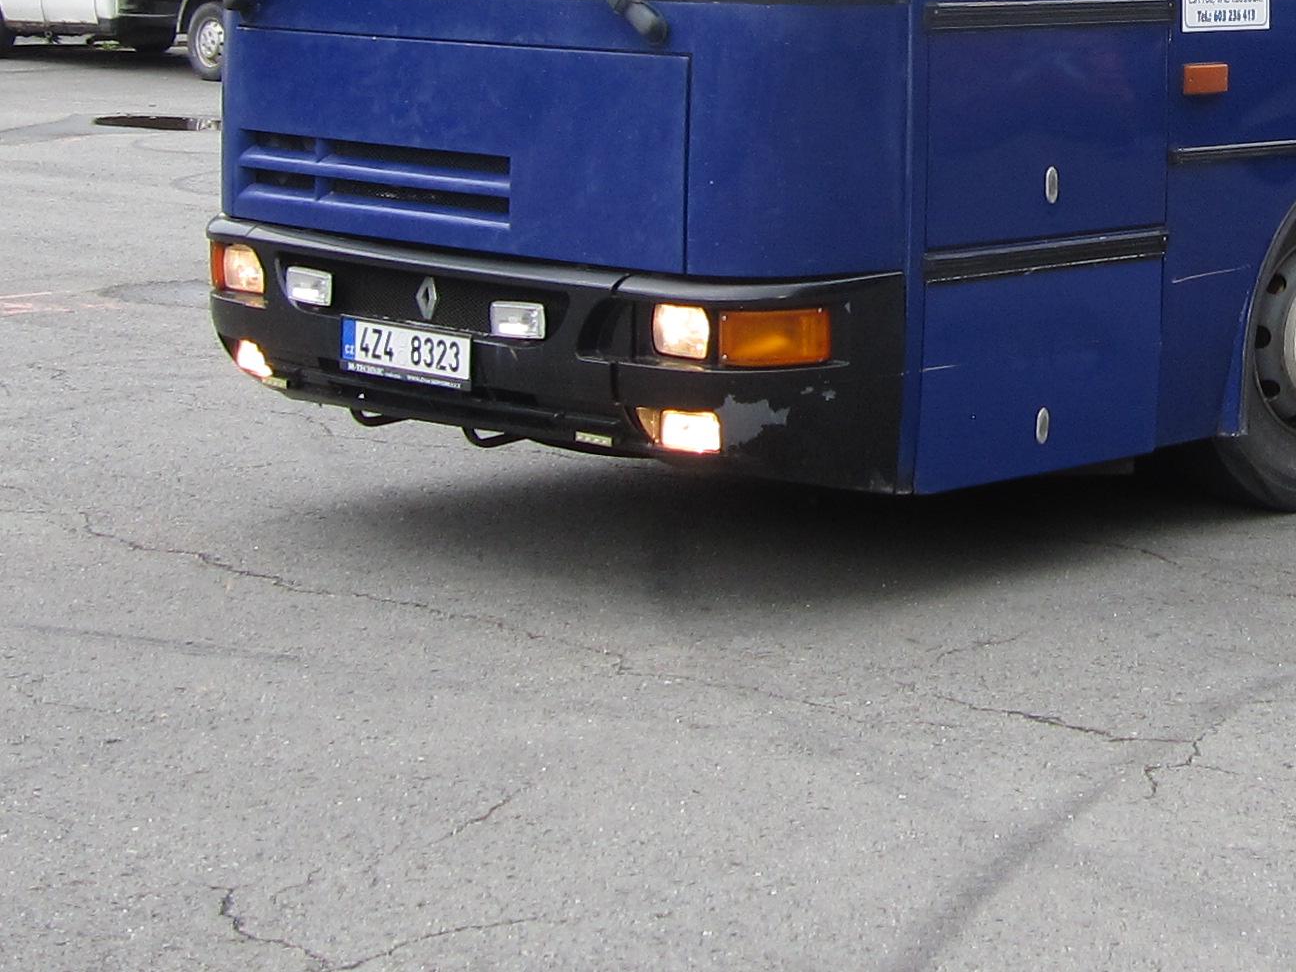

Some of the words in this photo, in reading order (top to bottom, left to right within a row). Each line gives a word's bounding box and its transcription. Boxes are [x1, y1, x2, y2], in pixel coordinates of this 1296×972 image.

[344, 344, 354, 355] CZ
[360, 327, 394, 362] 4Z4
[410, 335, 460, 373] 8323
